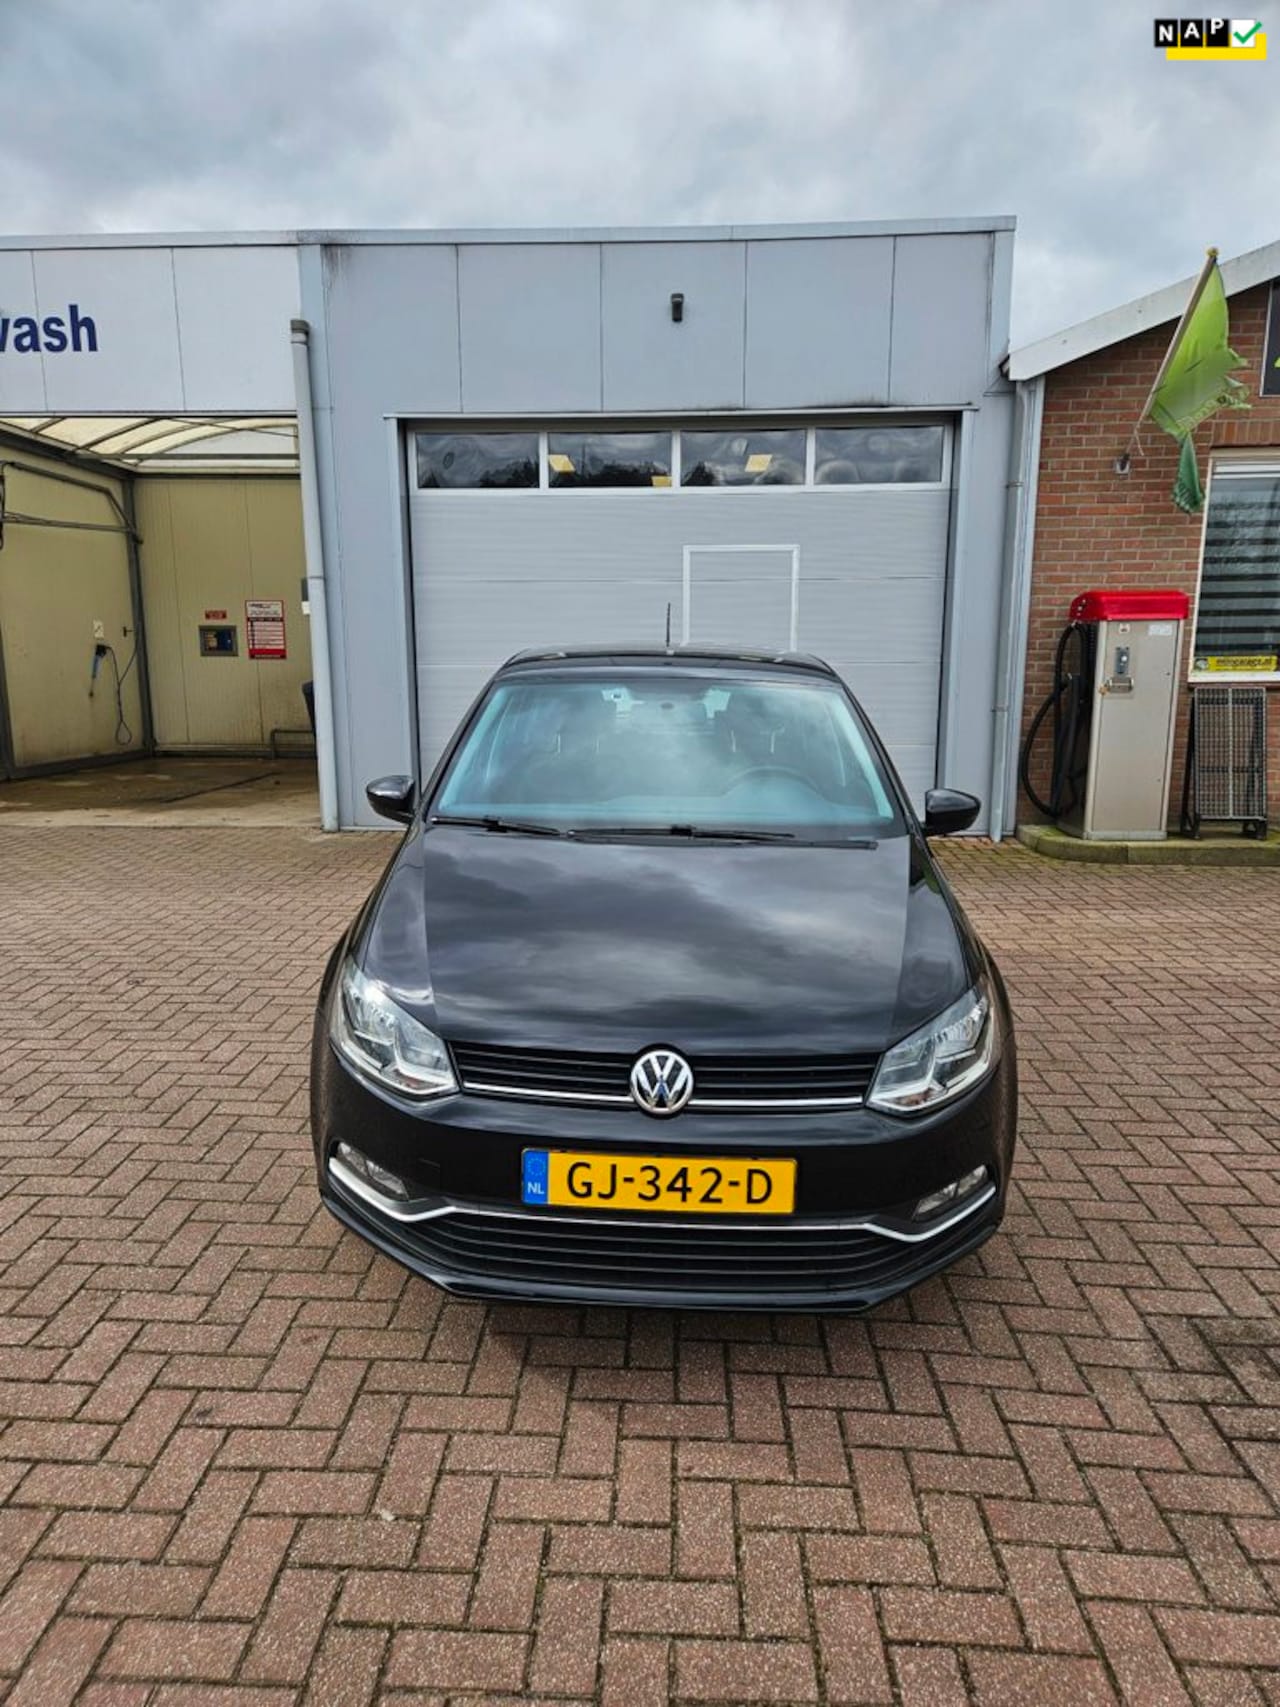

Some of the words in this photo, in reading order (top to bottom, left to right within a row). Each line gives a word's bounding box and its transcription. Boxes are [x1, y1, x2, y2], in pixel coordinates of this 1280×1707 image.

[0, 304, 98, 353] ash
[527, 1182, 545, 1195] NL
[566, 1162, 772, 1205] GJ-342-D
